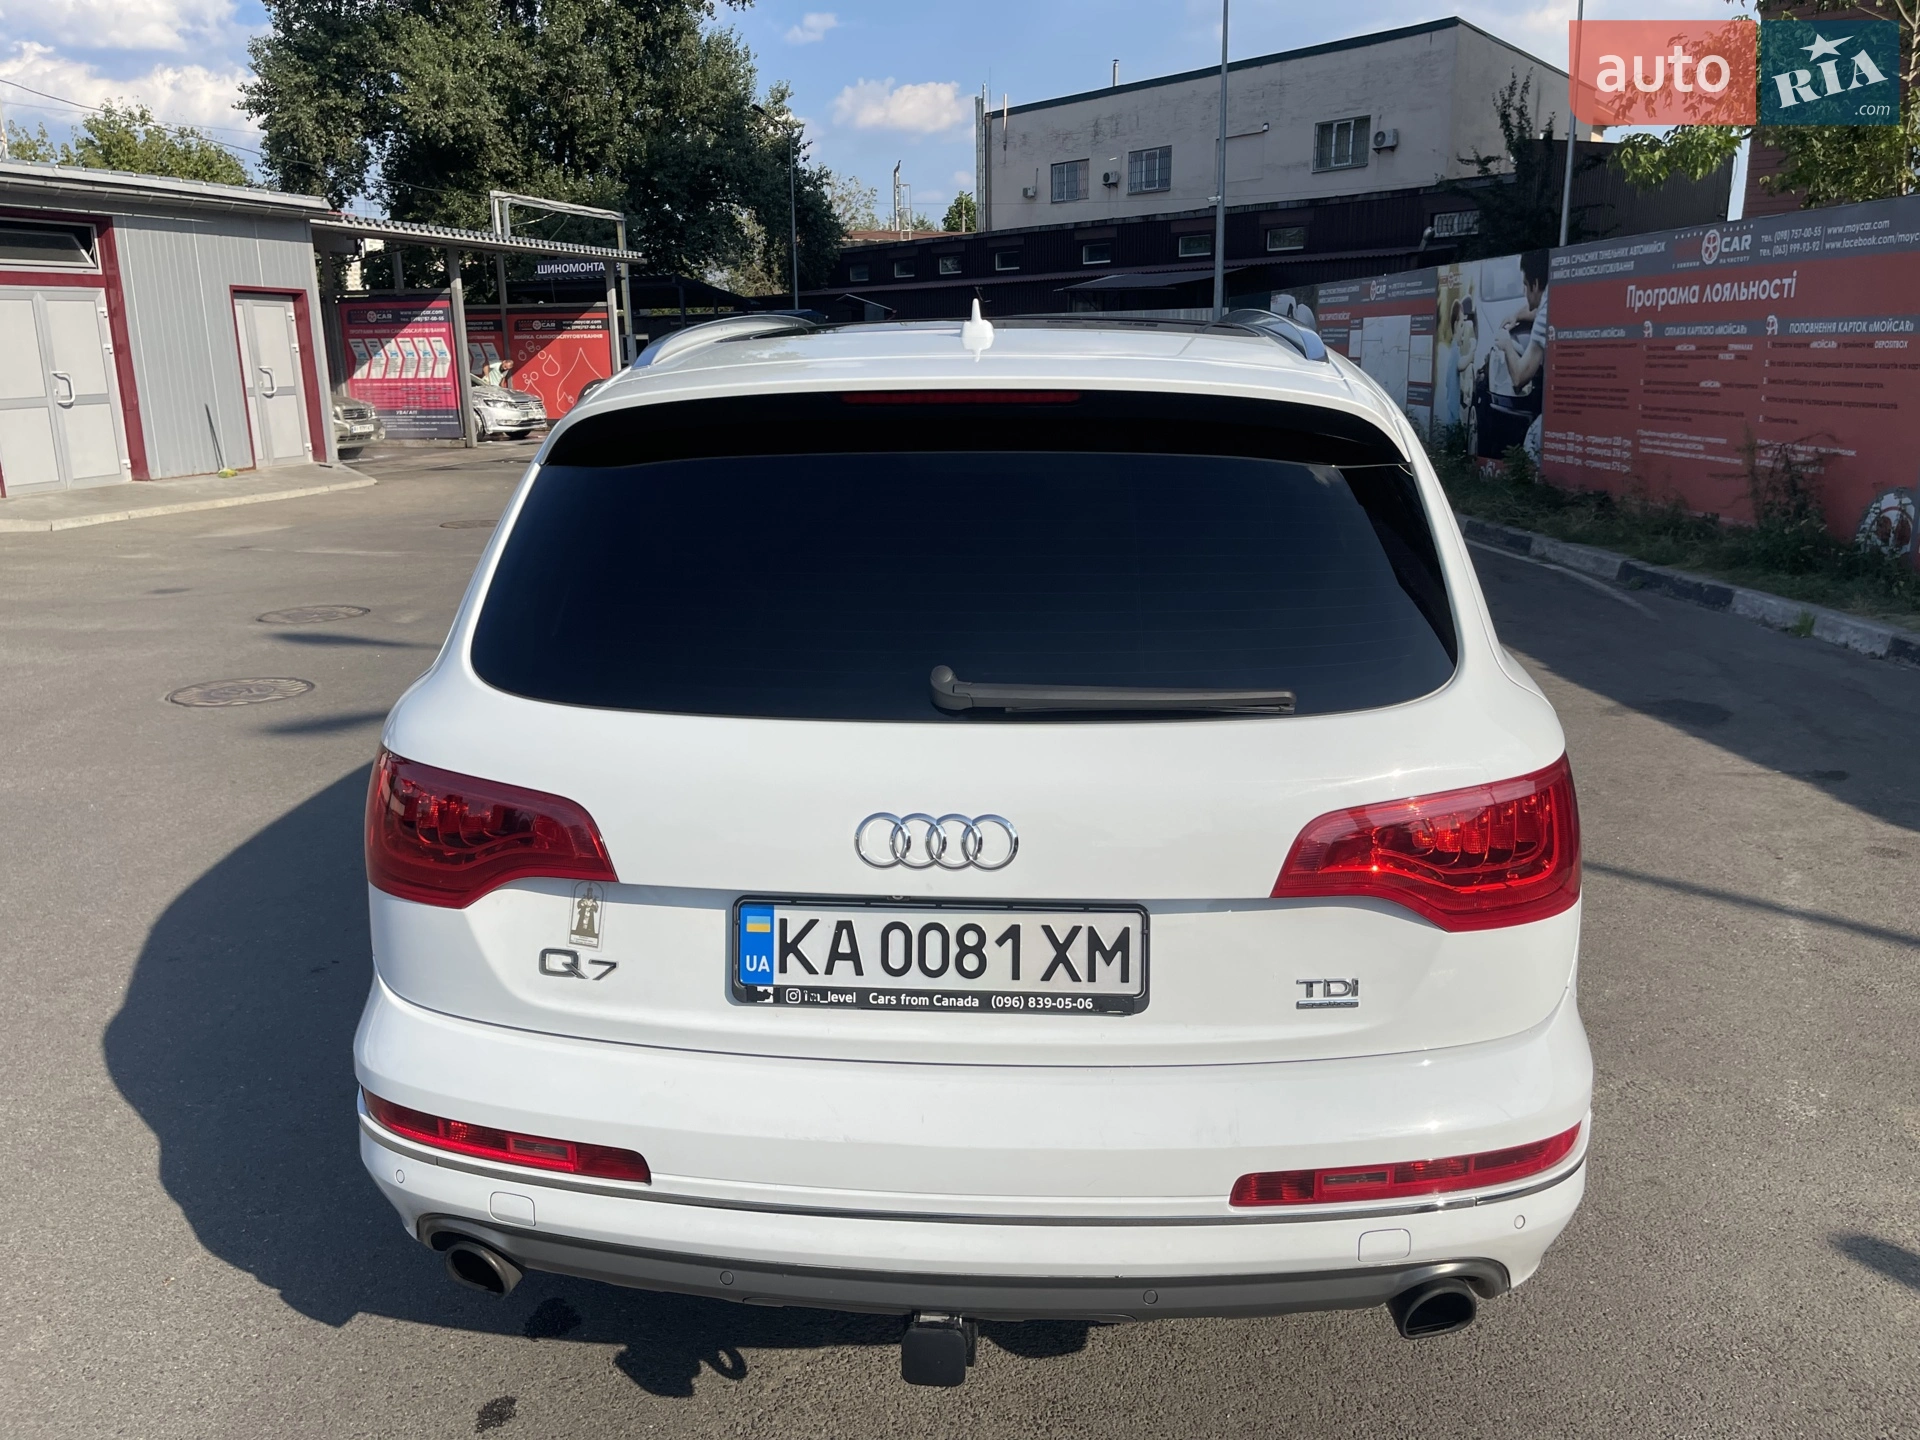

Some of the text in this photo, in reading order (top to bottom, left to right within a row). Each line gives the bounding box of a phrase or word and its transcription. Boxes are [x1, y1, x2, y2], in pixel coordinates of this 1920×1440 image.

[1774, 229, 1790, 243] (098)
[1791, 225, 1823, 240] 757-00-55
[1826, 218, 1890, 237] www.moycar.com
[1721, 234, 1752, 253] CAR
[1772, 243, 1788, 258] (063)
[1789, 240, 1820, 254] 999-93-92
[537, 261, 606, 274] ШИНОМОНТА
[1626, 270, 1798, 312] Програма лояльності
[1789, 322, 1837, 334] ПОПОВНЕННЯ
[1837, 321, 1867, 333] КАРТОК
[778, 917, 1131, 984] KA 0081 XM
[538, 948, 619, 981] Q7
[745, 954, 770, 972] UA
[1296, 978, 1359, 998] TDI
[869, 992, 897, 1005] Cars
[900, 993, 930, 1006] from
[933, 994, 980, 1007] Canada
[991, 995, 1025, 1009] (096)
[1027, 996, 1094, 1010] 839-05-06
